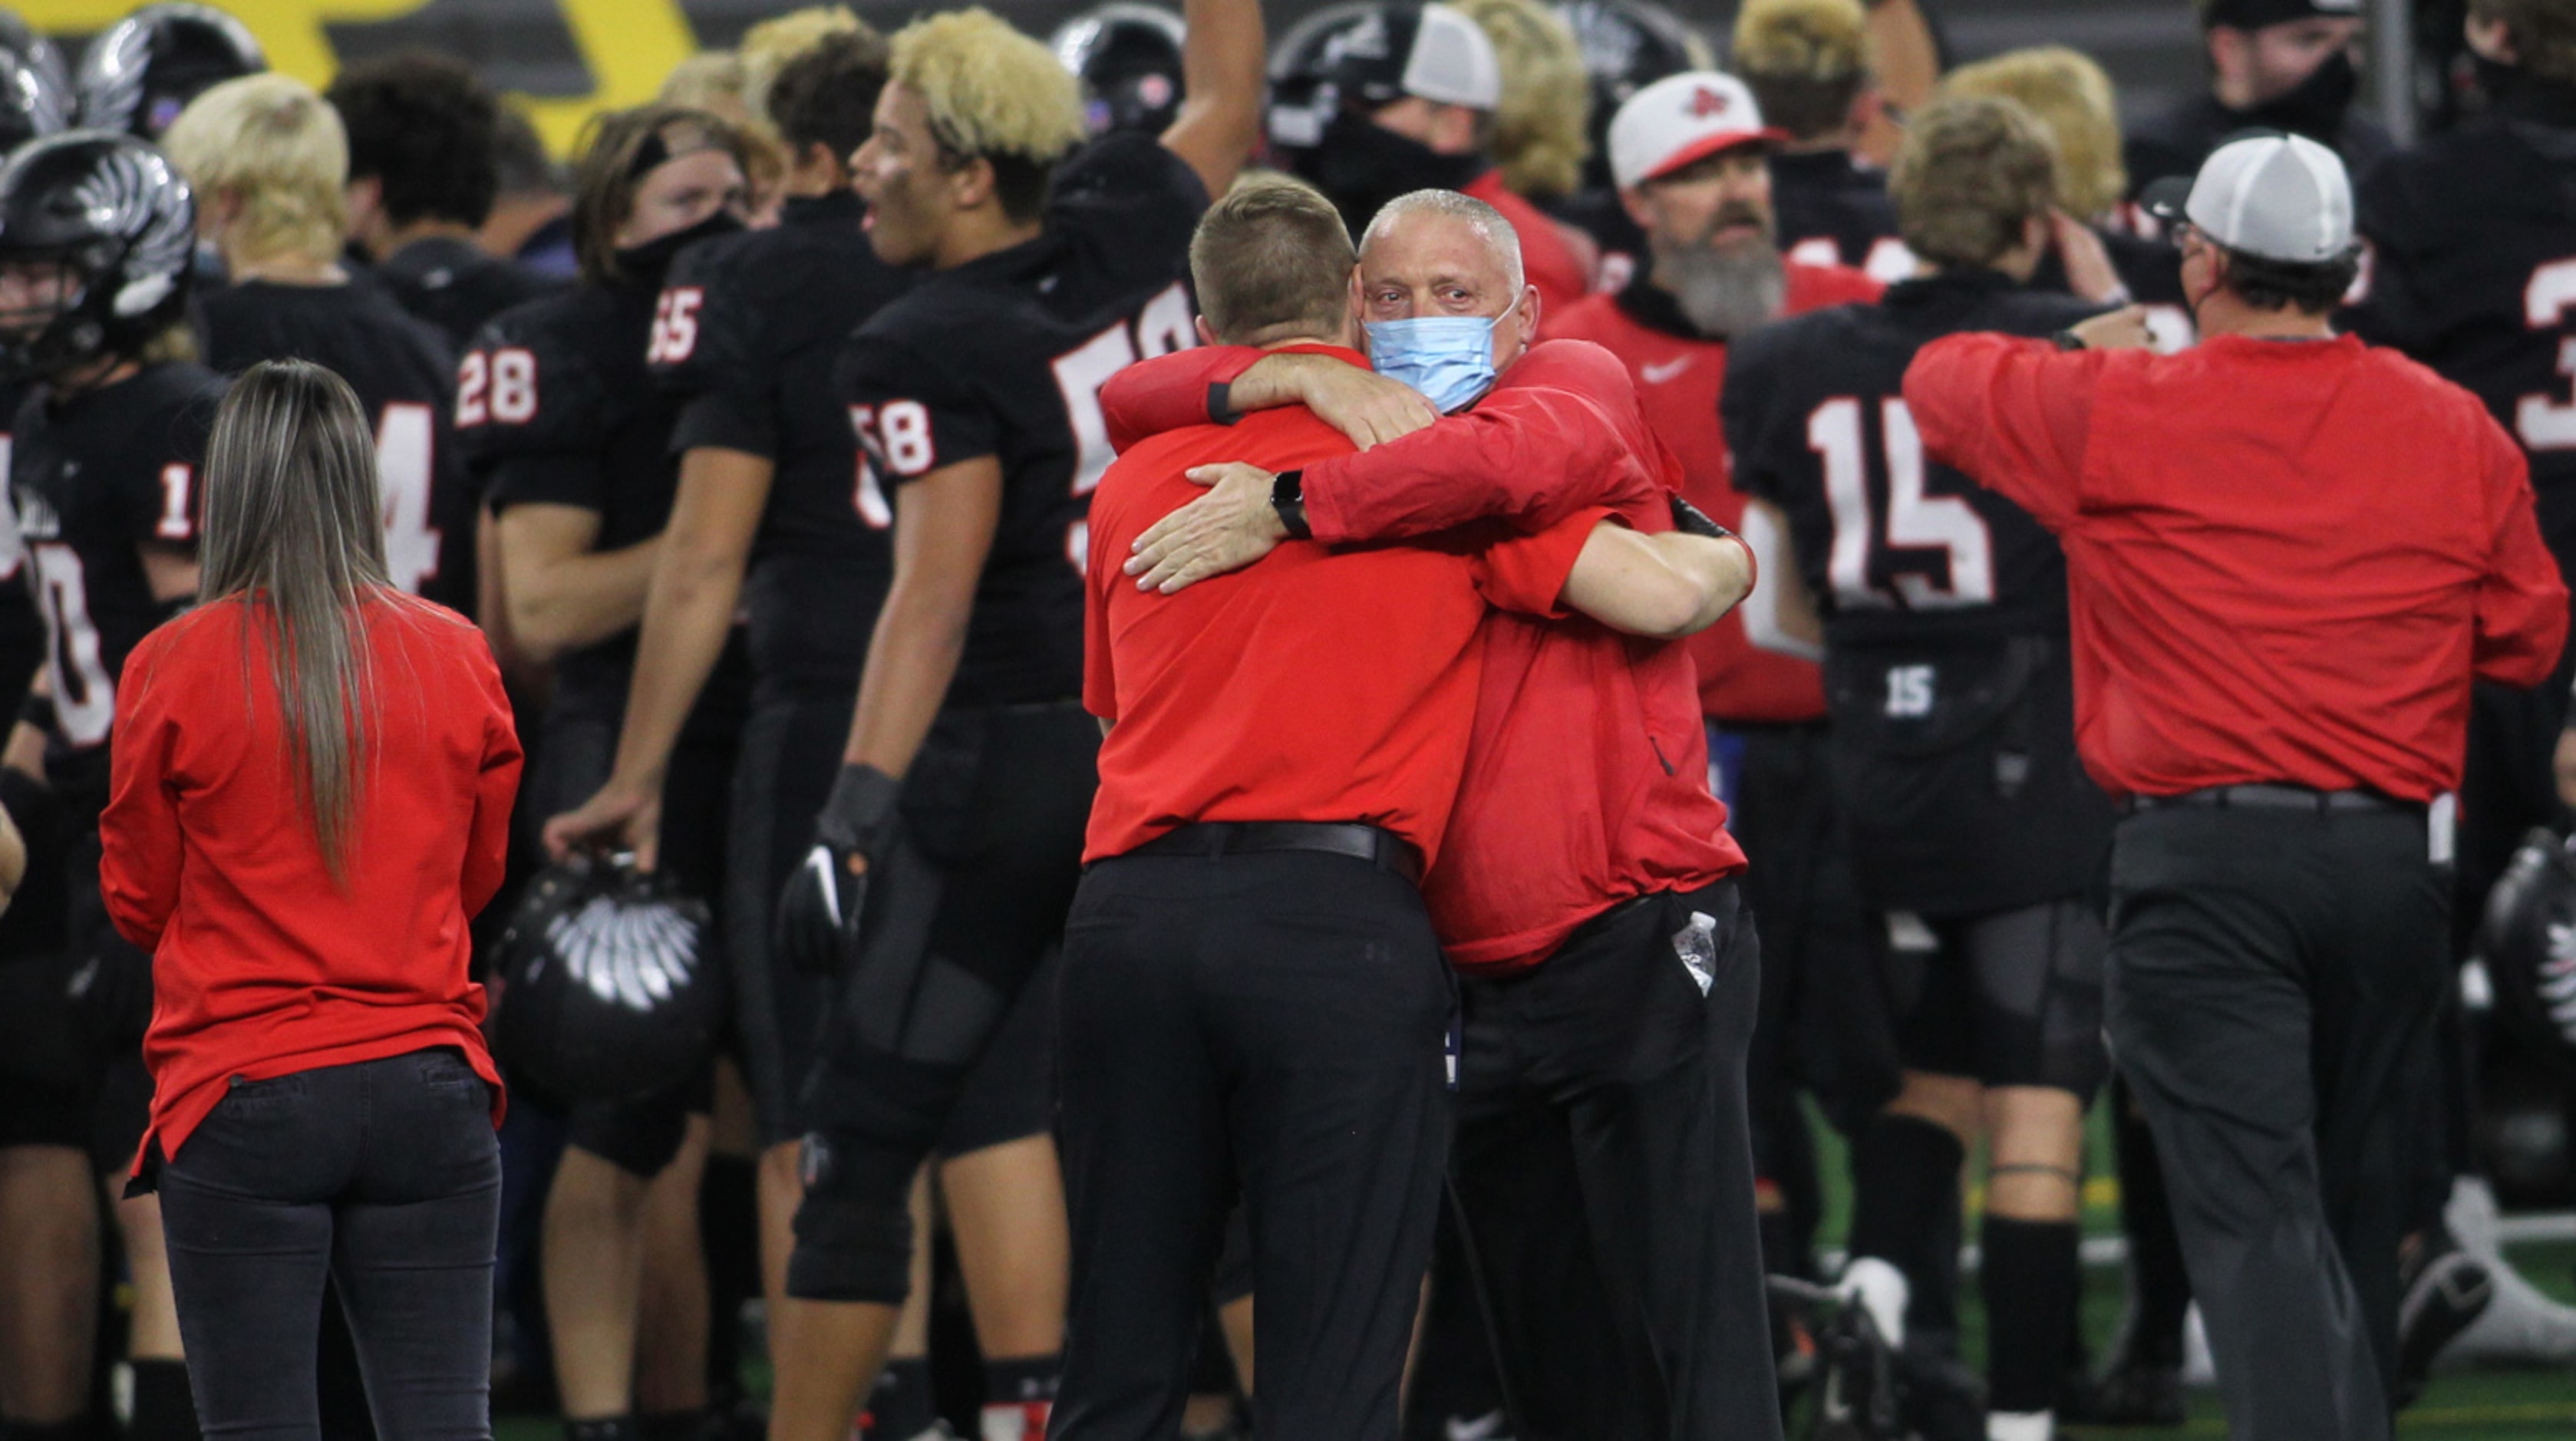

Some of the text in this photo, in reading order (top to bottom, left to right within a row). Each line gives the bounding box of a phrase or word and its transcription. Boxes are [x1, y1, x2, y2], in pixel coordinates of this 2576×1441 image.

[455, 348, 539, 428] 28
[1806, 394, 1996, 610] 15
[1885, 664, 1934, 716] 15
